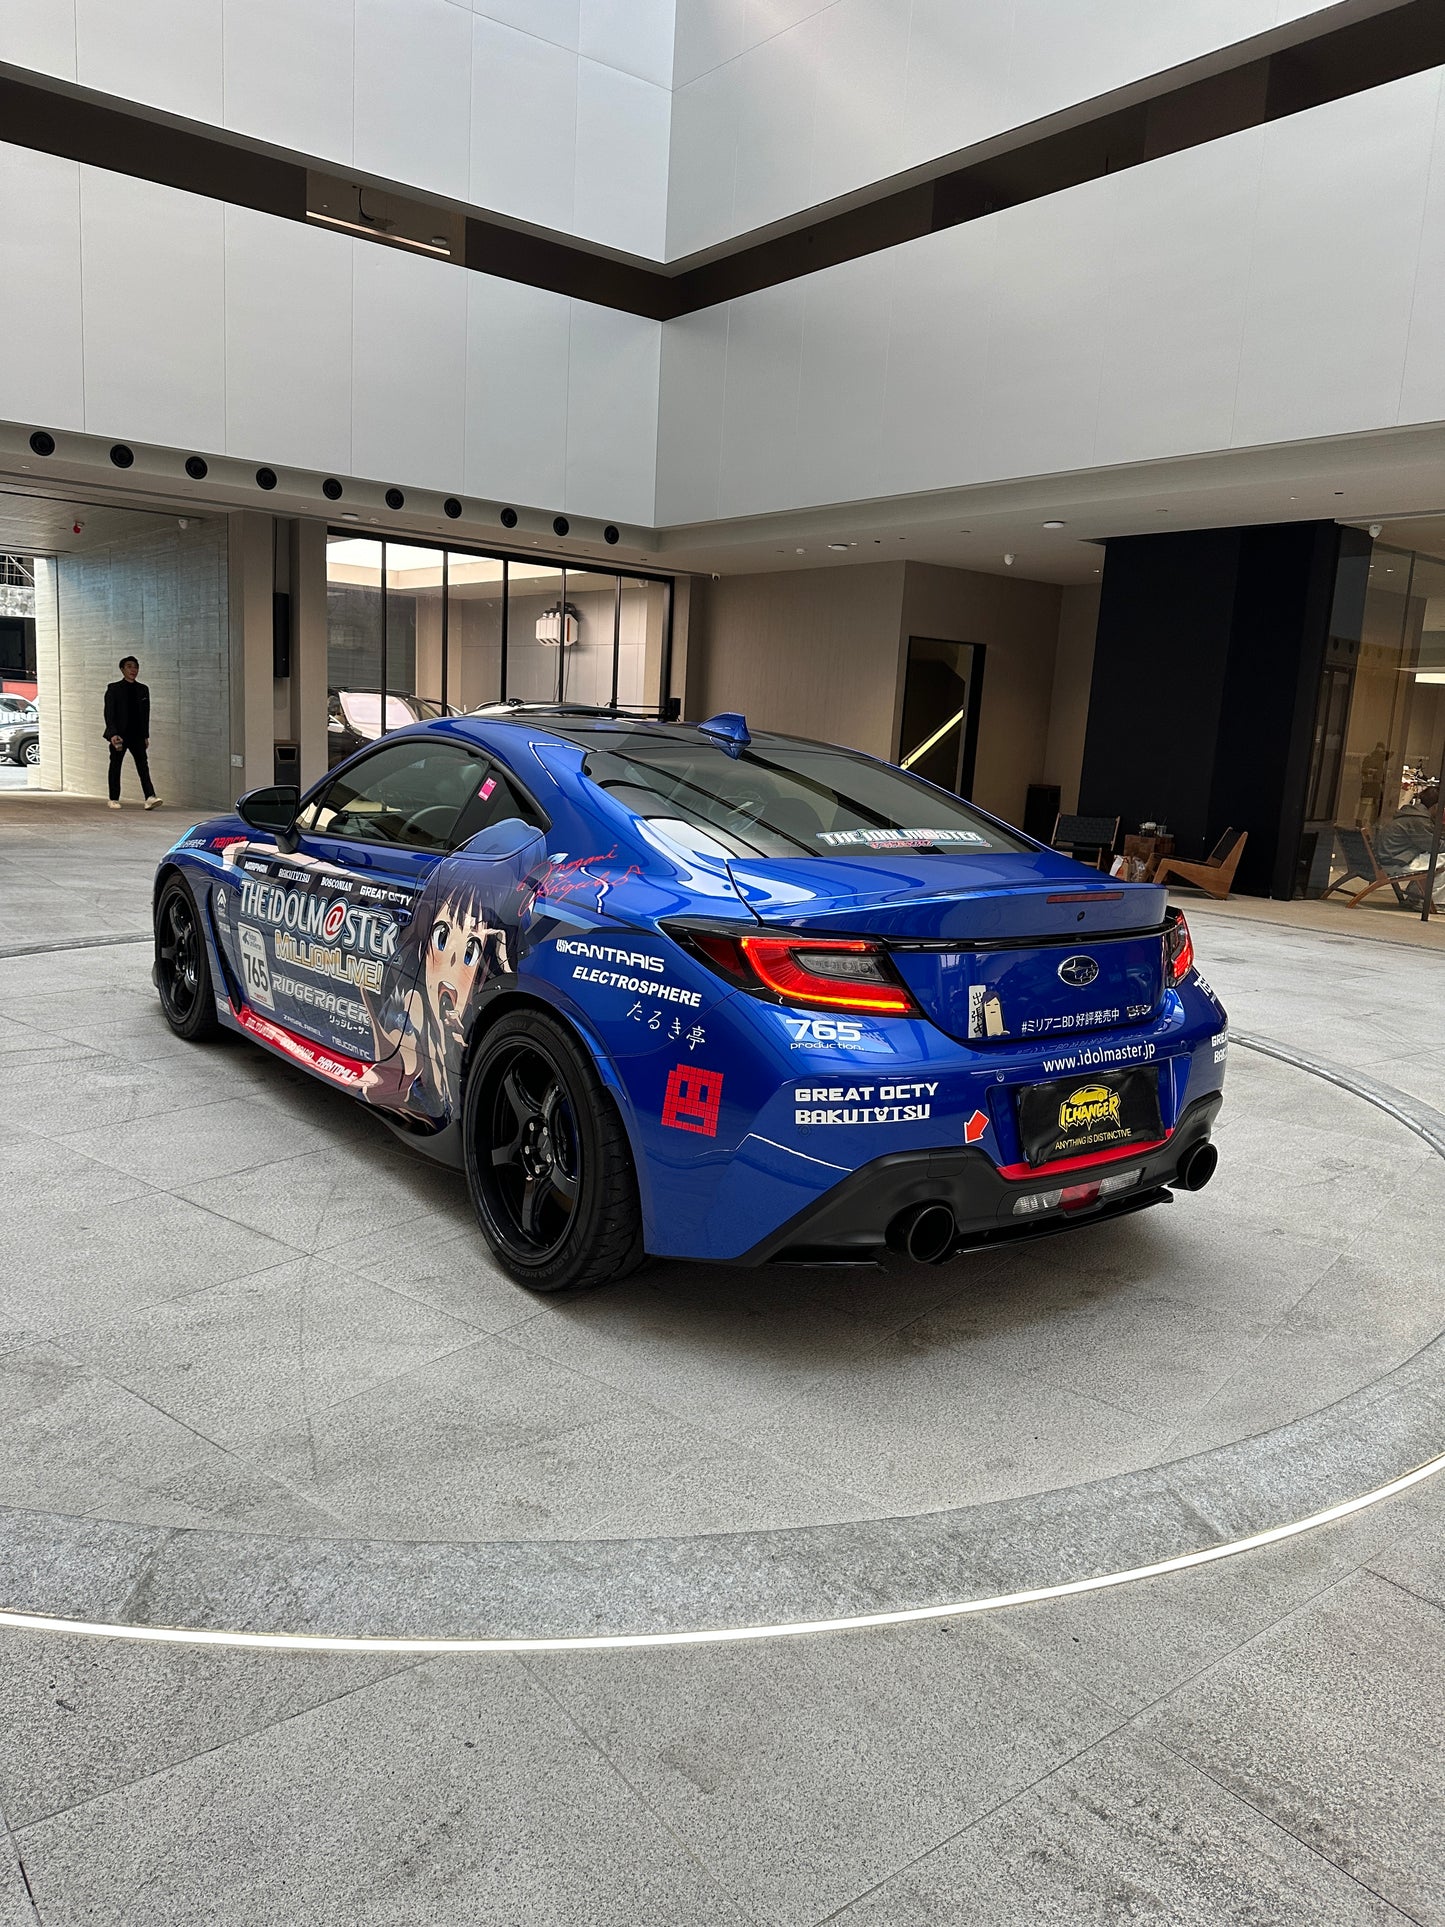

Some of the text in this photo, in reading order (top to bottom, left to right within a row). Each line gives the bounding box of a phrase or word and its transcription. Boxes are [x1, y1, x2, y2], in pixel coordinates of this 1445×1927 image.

[359, 885, 388, 901] GREAT
[565, 940, 665, 973] KANTARIS
[243, 952, 269, 993] 765
[572, 965, 703, 1008] ELECTROSPHERE
[626, 1001, 706, 1051] たるき亭
[785, 1019, 863, 1042] 765
[1075, 1007, 1120, 1027] 好評発売中
[1042, 1040, 1156, 1073] www.idolmaster.jp
[795, 1082, 939, 1102] GREAT OCTY
[1055, 1128, 1132, 1150] ANYTHING IS DISTINCTIVE
